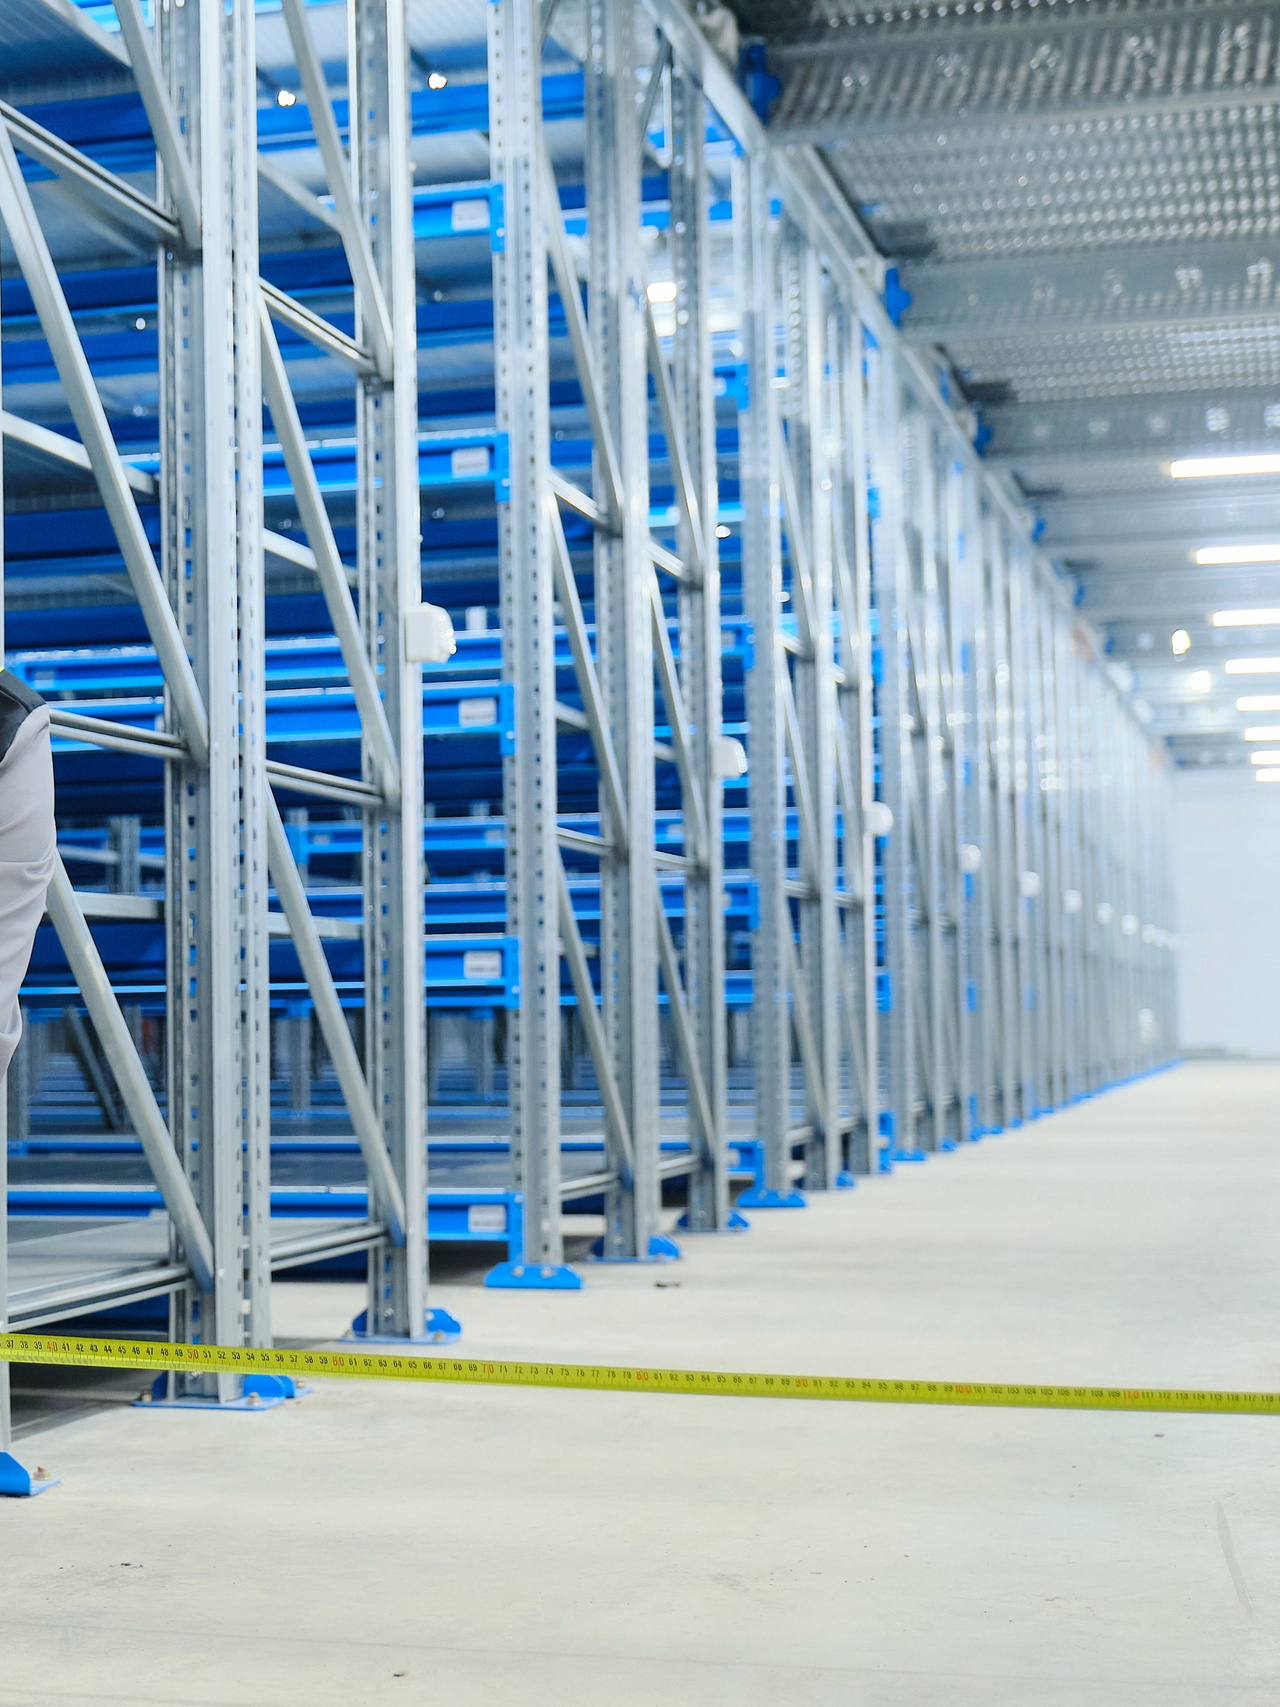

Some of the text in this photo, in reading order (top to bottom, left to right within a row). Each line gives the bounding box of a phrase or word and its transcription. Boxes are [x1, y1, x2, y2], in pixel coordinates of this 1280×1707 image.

[6, 1339, 14, 1348] 37
[20, 1340, 28, 1349] 38
[33, 1341, 42, 1350] 39
[46, 1340, 58, 1352] 40
[62, 1342, 70, 1351] 41
[75, 1343, 84, 1352] 42
[89, 1344, 98, 1353] 43
[103, 1344, 112, 1353] 44
[117, 1345, 126, 1354] 45
[131, 1346, 140, 1355] 46
[146, 1347, 153, 1356] 47
[160, 1347, 168, 1356] 48
[174, 1348, 183, 1357] 49
[186, 1348, 199, 1359] 50
[202, 1350, 211, 1358] 51
[217, 1351, 226, 1359] 52
[231, 1351, 240, 1360] 53
[246, 1352, 255, 1361] 54
[260, 1353, 269, 1361] 55
[274, 1354, 284, 1362] 56
[289, 1354, 297, 1363] 57
[304, 1355, 313, 1364] 58
[318, 1356, 328, 1364] 59
[332, 1356, 344, 1366] 60
[348, 1357, 357, 1366] 61
[363, 1358, 372, 1366] 62
[378, 1359, 387, 1367] 63
[392, 1360, 402, 1368] 64
[408, 1360, 417, 1369] 65
[422, 1361, 432, 1370] 66
[438, 1362, 446, 1370] 67
[452, 1362, 462, 1371] 68
[468, 1363, 477, 1372] 69
[482, 1364, 494, 1373] 70
[499, 1365, 508, 1373] 71
[514, 1366, 522, 1374] 72
[530, 1366, 538, 1375] 73
[545, 1367, 554, 1375] 74
[560, 1368, 570, 1376] 75
[576, 1368, 585, 1377] 76
[591, 1369, 599, 1378] 77
[607, 1370, 616, 1378] 78
[622, 1371, 632, 1379] 79
[636, 1371, 649, 1380] 80
[653, 1372, 662, 1380] 81
[669, 1373, 678, 1381] 82
[685, 1373, 694, 1382] 83
[700, 1374, 710, 1382] 84
[716, 1375, 726, 1383] 85
[732, 1375, 742, 1384] 86
[748, 1376, 757, 1384] 87
[764, 1377, 774, 1385] 88
[780, 1378, 790, 1386] 89
[794, 1378, 808, 1387] 90
[812, 1379, 822, 1387] 91
[828, 1380, 838, 1388] 92
[845, 1380, 855, 1389] 93
[861, 1381, 871, 1389] 94
[877, 1382, 887, 1390] 95
[894, 1382, 904, 1390] 96
[910, 1383, 919, 1391] 97
[926, 1383, 936, 1392] 98
[943, 1384, 953, 1392] 99
